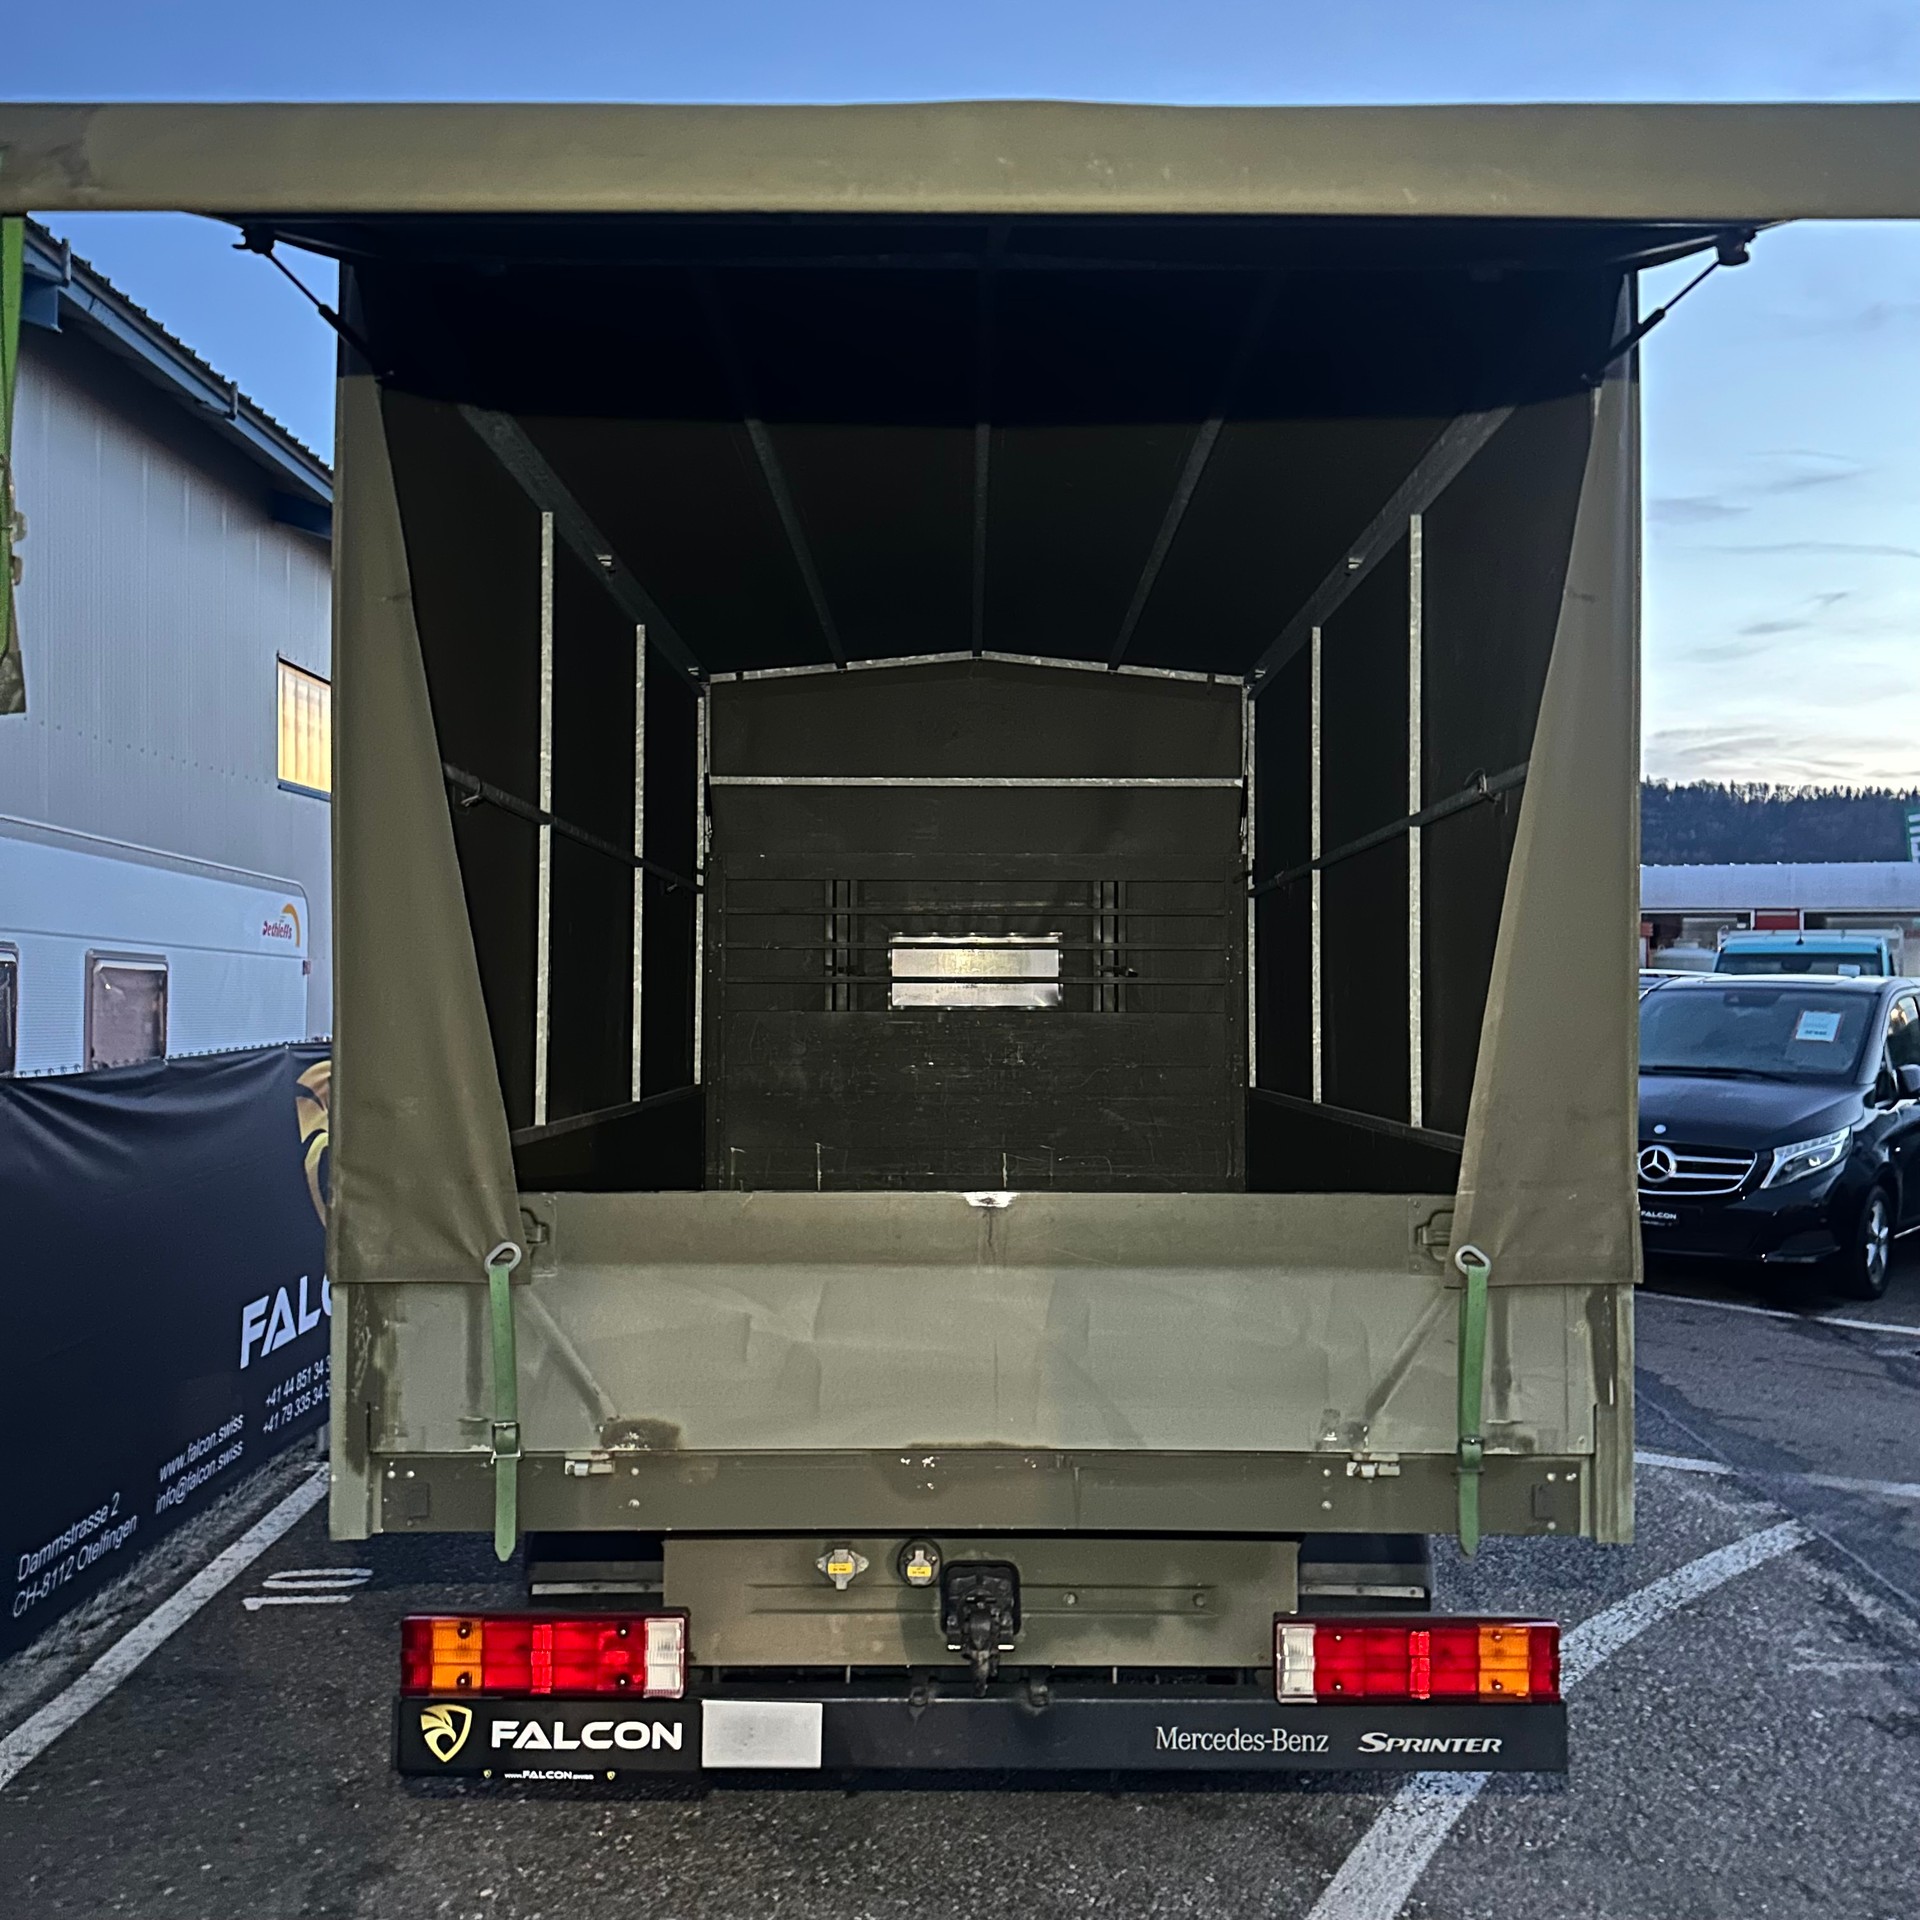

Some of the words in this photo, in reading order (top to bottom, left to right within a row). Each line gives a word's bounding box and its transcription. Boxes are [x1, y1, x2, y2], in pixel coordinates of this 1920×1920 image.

[262, 1412, 279, 1434] +41
[281, 1403, 293, 1425] 79
[294, 1391, 311, 1417] 335
[312, 1384, 323, 1405] 34
[266, 1384, 282, 1407] +41
[283, 1376, 294, 1397] 44
[296, 1366, 312, 1391] 851
[314, 1359, 324, 1380] 34
[155, 1440, 243, 1514] info@falcon.swiss
[160, 1414, 244, 1482] www.falcon.swiss
[13, 1555, 75, 1617] CH-8112
[77, 1515, 138, 1571] Otelfingen
[17, 1505, 109, 1582] Dammstrasse
[111, 1492, 120, 1517] 2
[491, 1720, 683, 1750] FALCON
[1156, 1726, 1329, 1752] Mercedes-Benz
